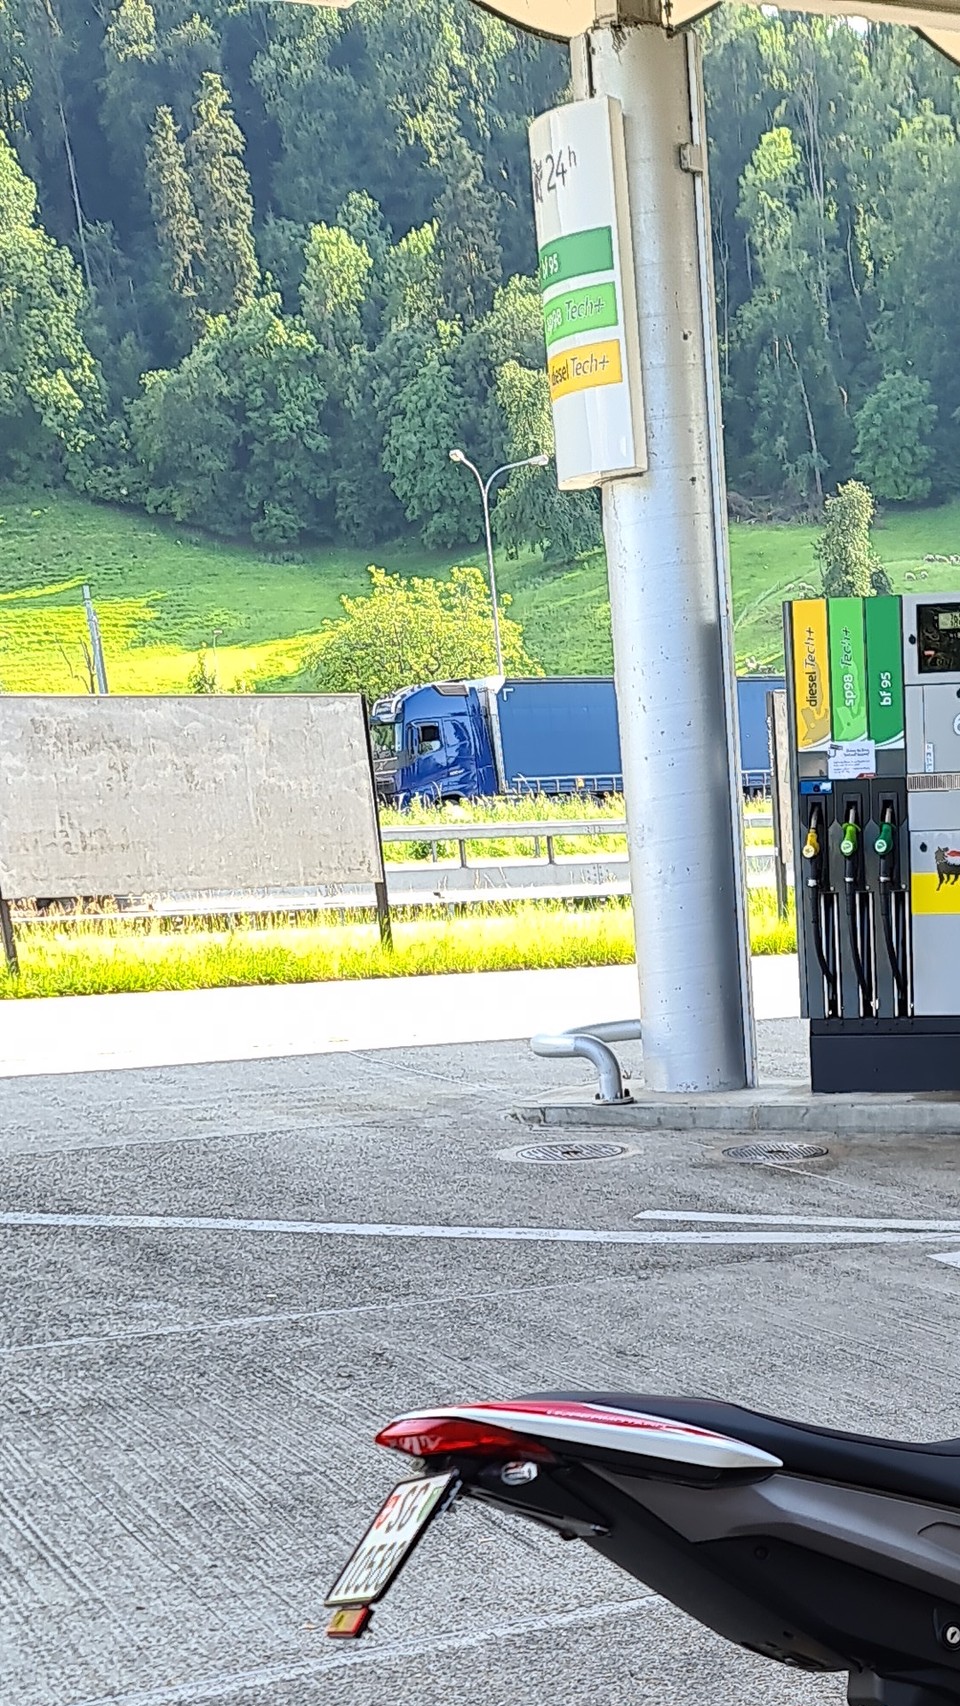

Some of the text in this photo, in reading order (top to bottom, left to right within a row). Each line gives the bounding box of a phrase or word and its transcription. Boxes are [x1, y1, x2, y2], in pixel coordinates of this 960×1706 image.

[565, 297, 605, 321] Tech+
[570, 353, 609, 378] Tech+
[804, 627, 818, 707] diesel Tech+
[841, 627, 857, 707] sp98 Tech+
[879, 672, 892, 706] bf 95
[384, 1482, 431, 1534] SG
